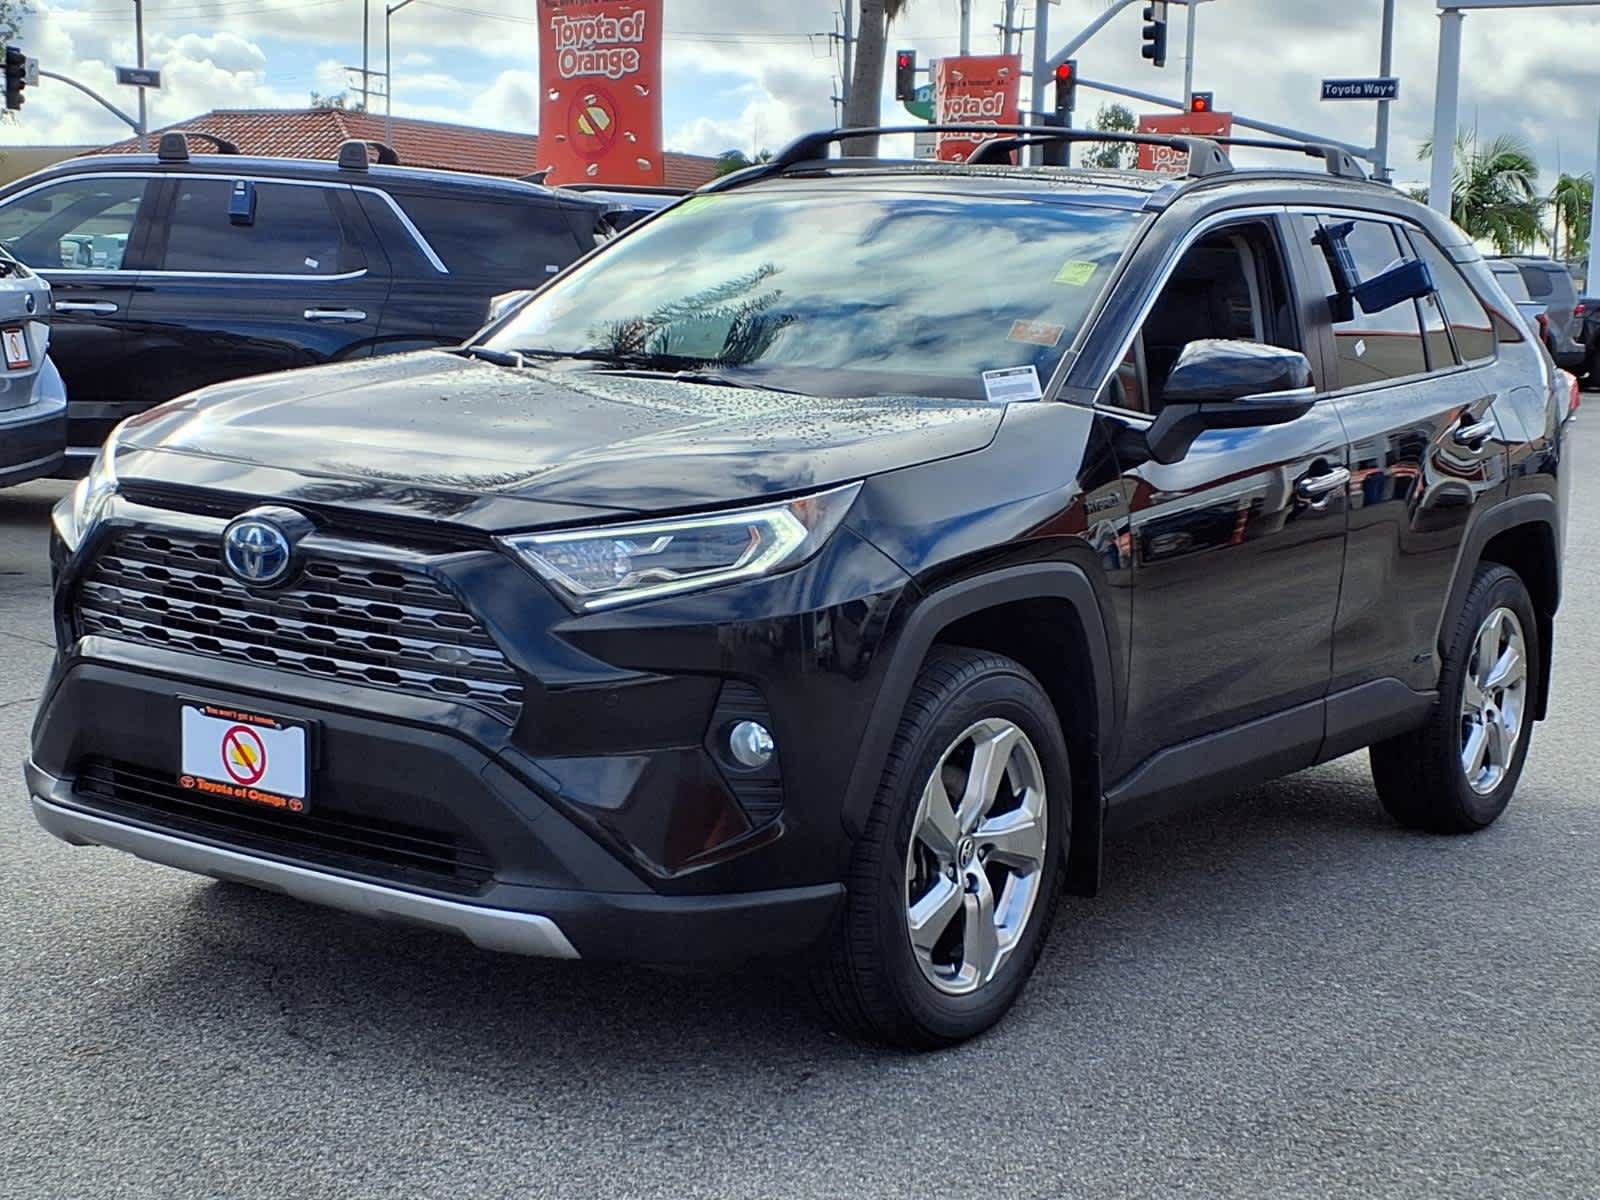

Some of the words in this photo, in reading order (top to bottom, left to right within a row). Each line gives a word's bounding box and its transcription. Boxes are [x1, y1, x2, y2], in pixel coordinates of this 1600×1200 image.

[551, 12, 618, 50] Toyota
[619, 10, 645, 42] of
[558, 47, 640, 79] Orange
[1325, 84, 1361, 97] Toyota
[1364, 83, 1387, 96] Way
[944, 94, 981, 121] yota
[981, 92, 1004, 117] of
[1149, 144, 1189, 163] Toyo
[196, 778, 233, 794] Toyota
[234, 788, 247, 798] of
[248, 789, 287, 807] Orange
